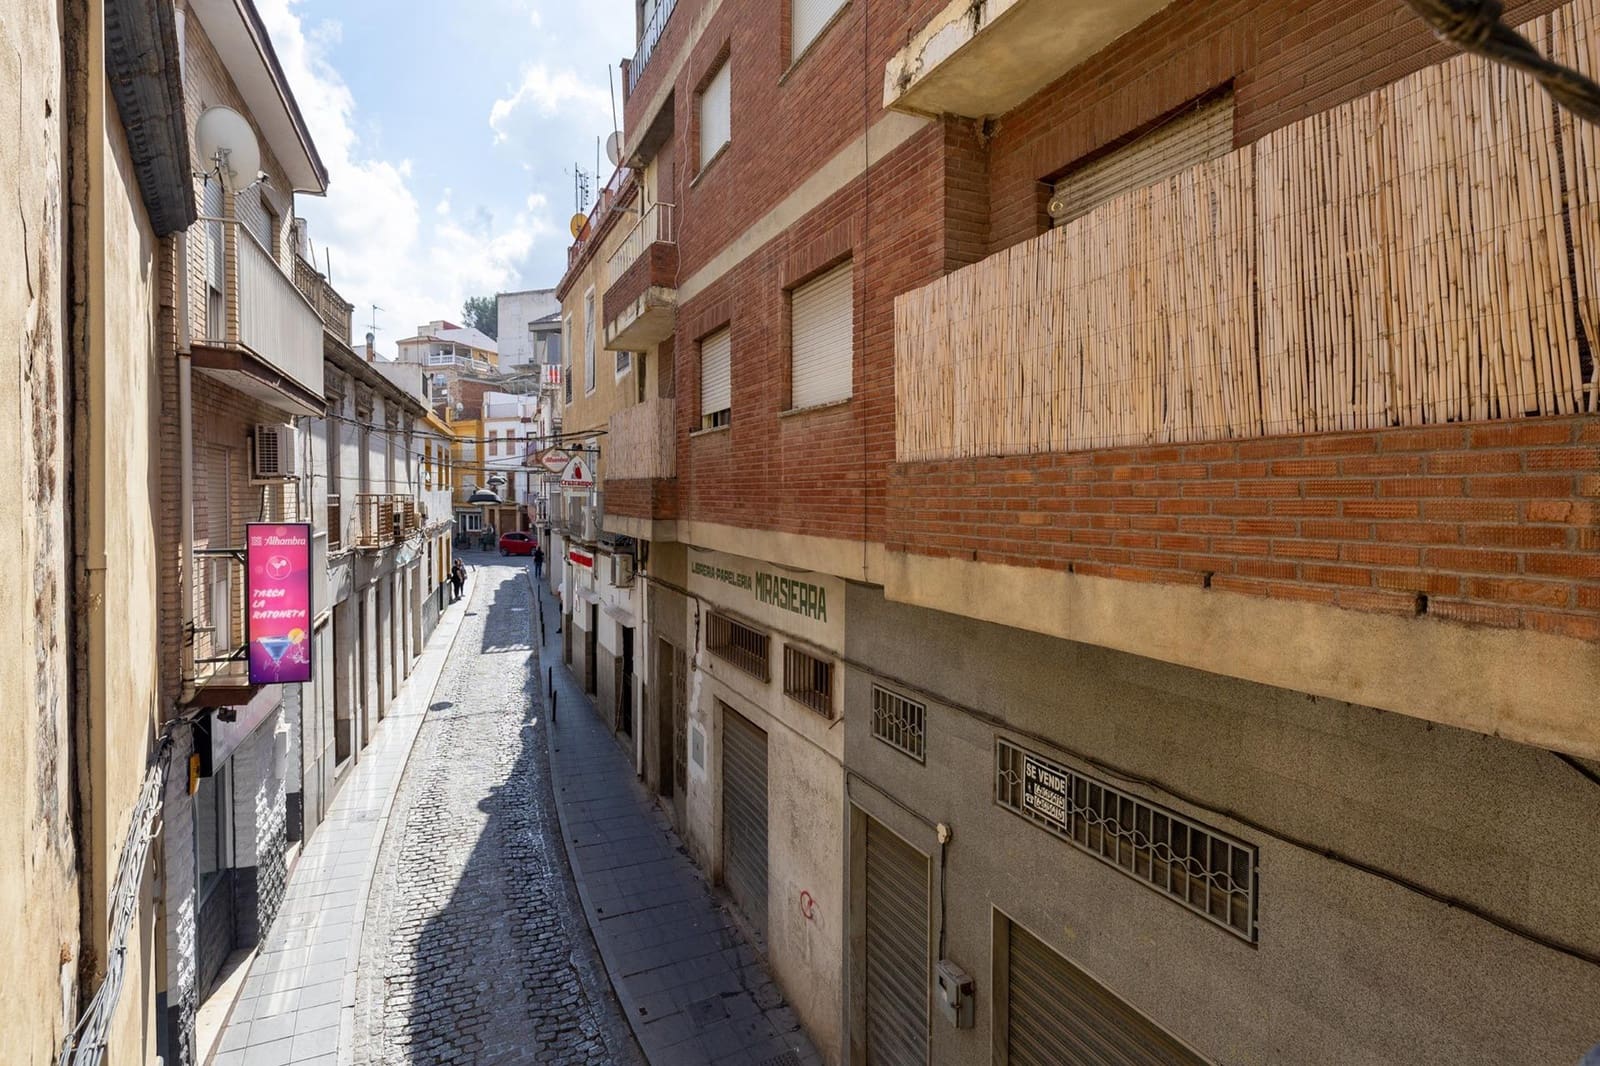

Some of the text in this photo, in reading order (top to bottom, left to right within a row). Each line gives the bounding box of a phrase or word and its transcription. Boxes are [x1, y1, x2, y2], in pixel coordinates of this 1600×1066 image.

[264, 535, 306, 546] Alhambra
[755, 570, 827, 623] MIRASIERRA
[252, 600, 266, 609] LA
[252, 610, 306, 620] RATONETA
[1026, 762, 1066, 795] SE VENDE
